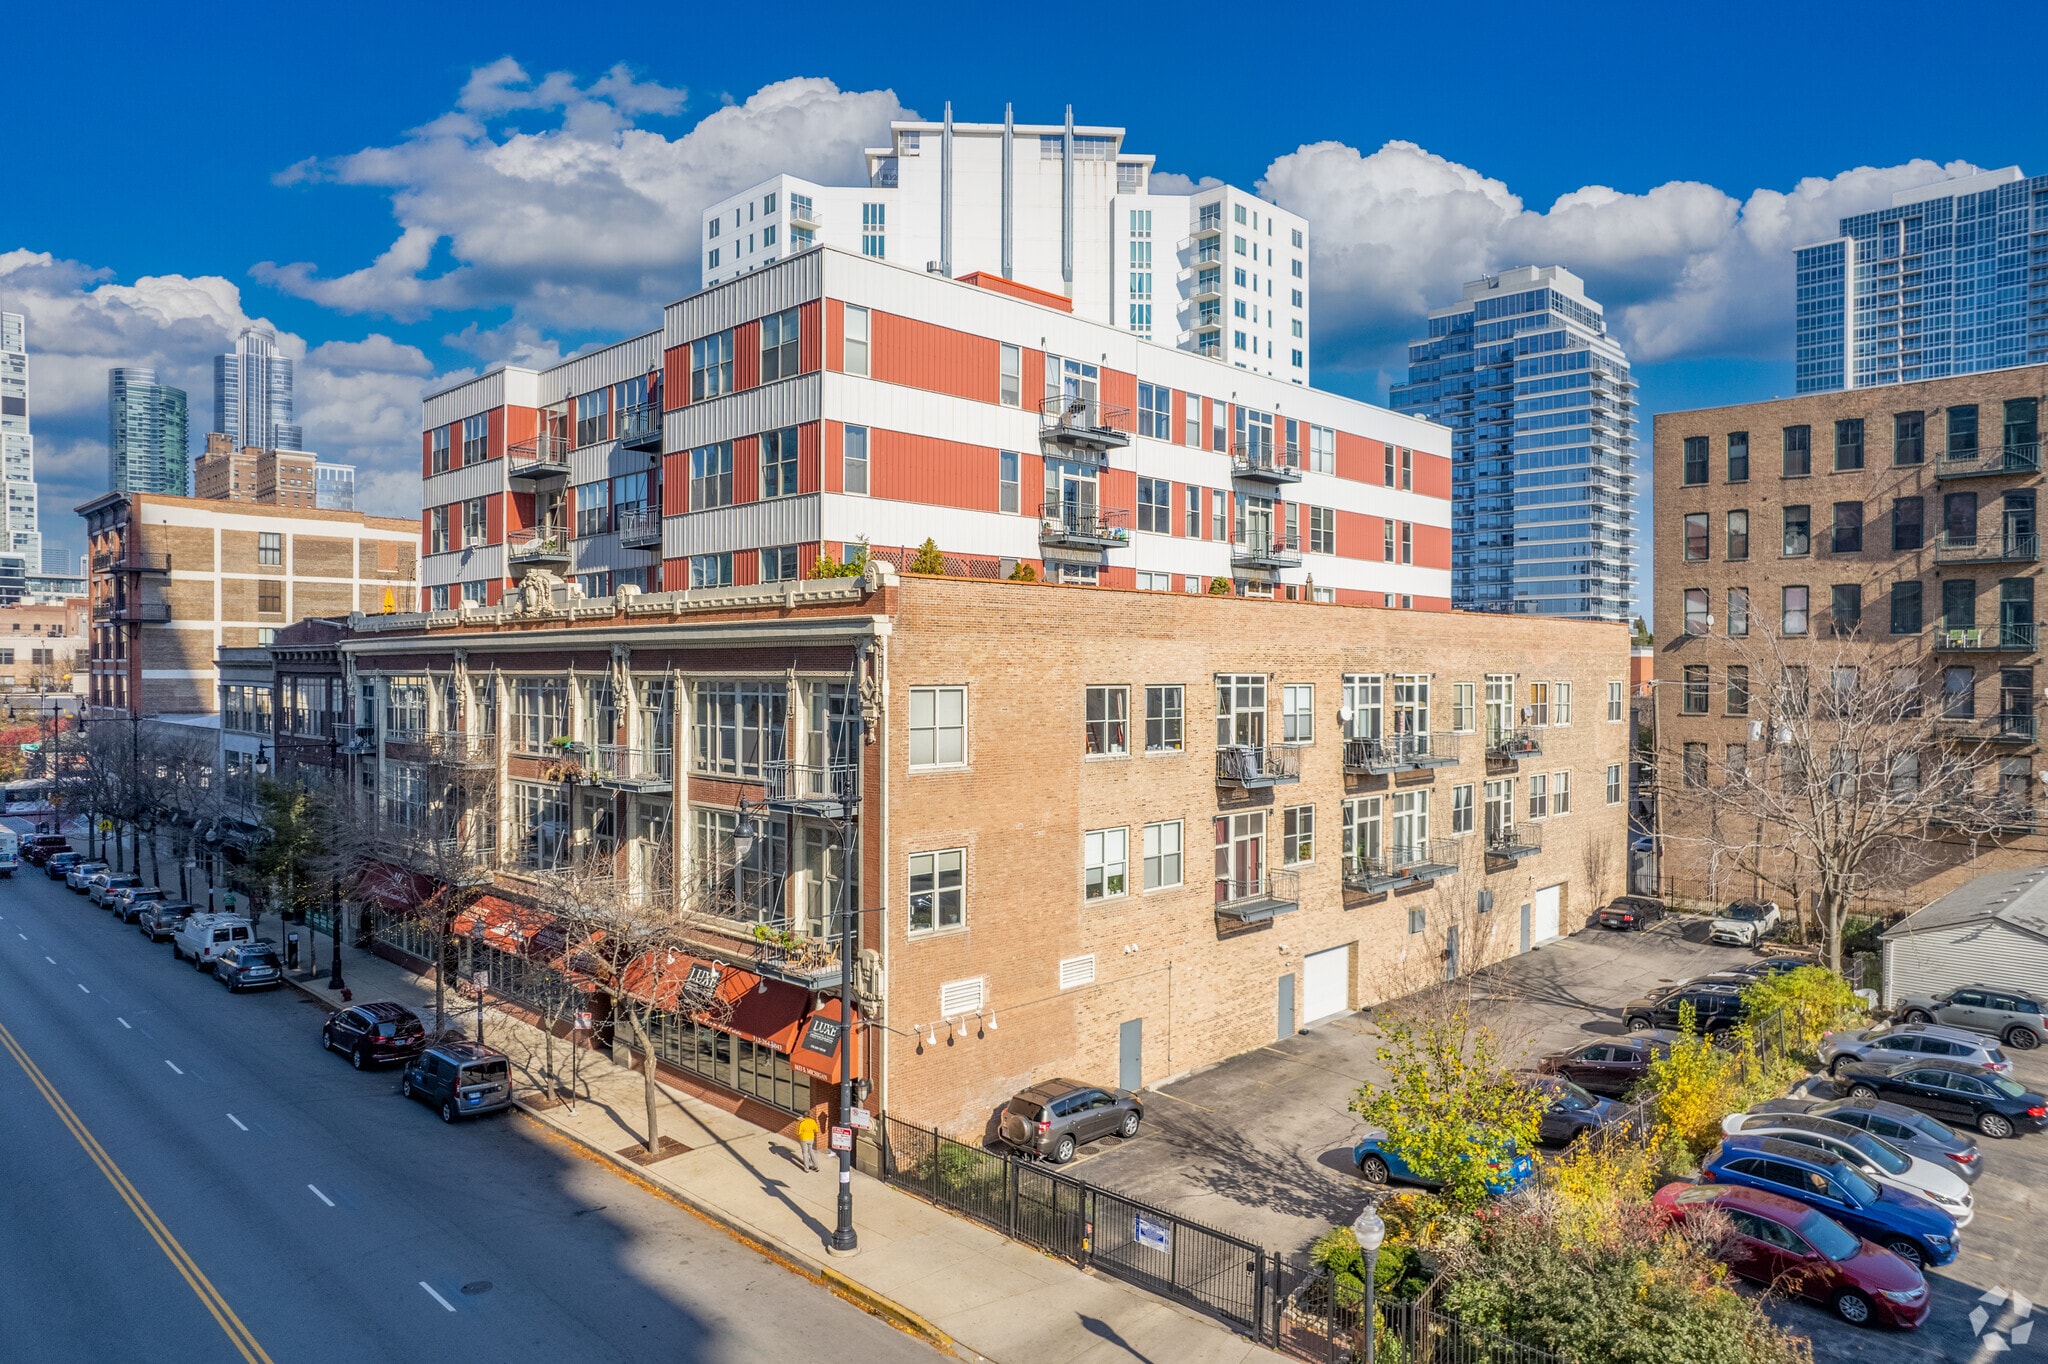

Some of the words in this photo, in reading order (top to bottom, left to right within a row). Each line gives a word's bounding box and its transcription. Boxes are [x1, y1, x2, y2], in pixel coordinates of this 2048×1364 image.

[686, 967, 720, 988] LUXE
[813, 1020, 839, 1037] LUXE
[806, 1068, 828, 1081] MICHIGAN
